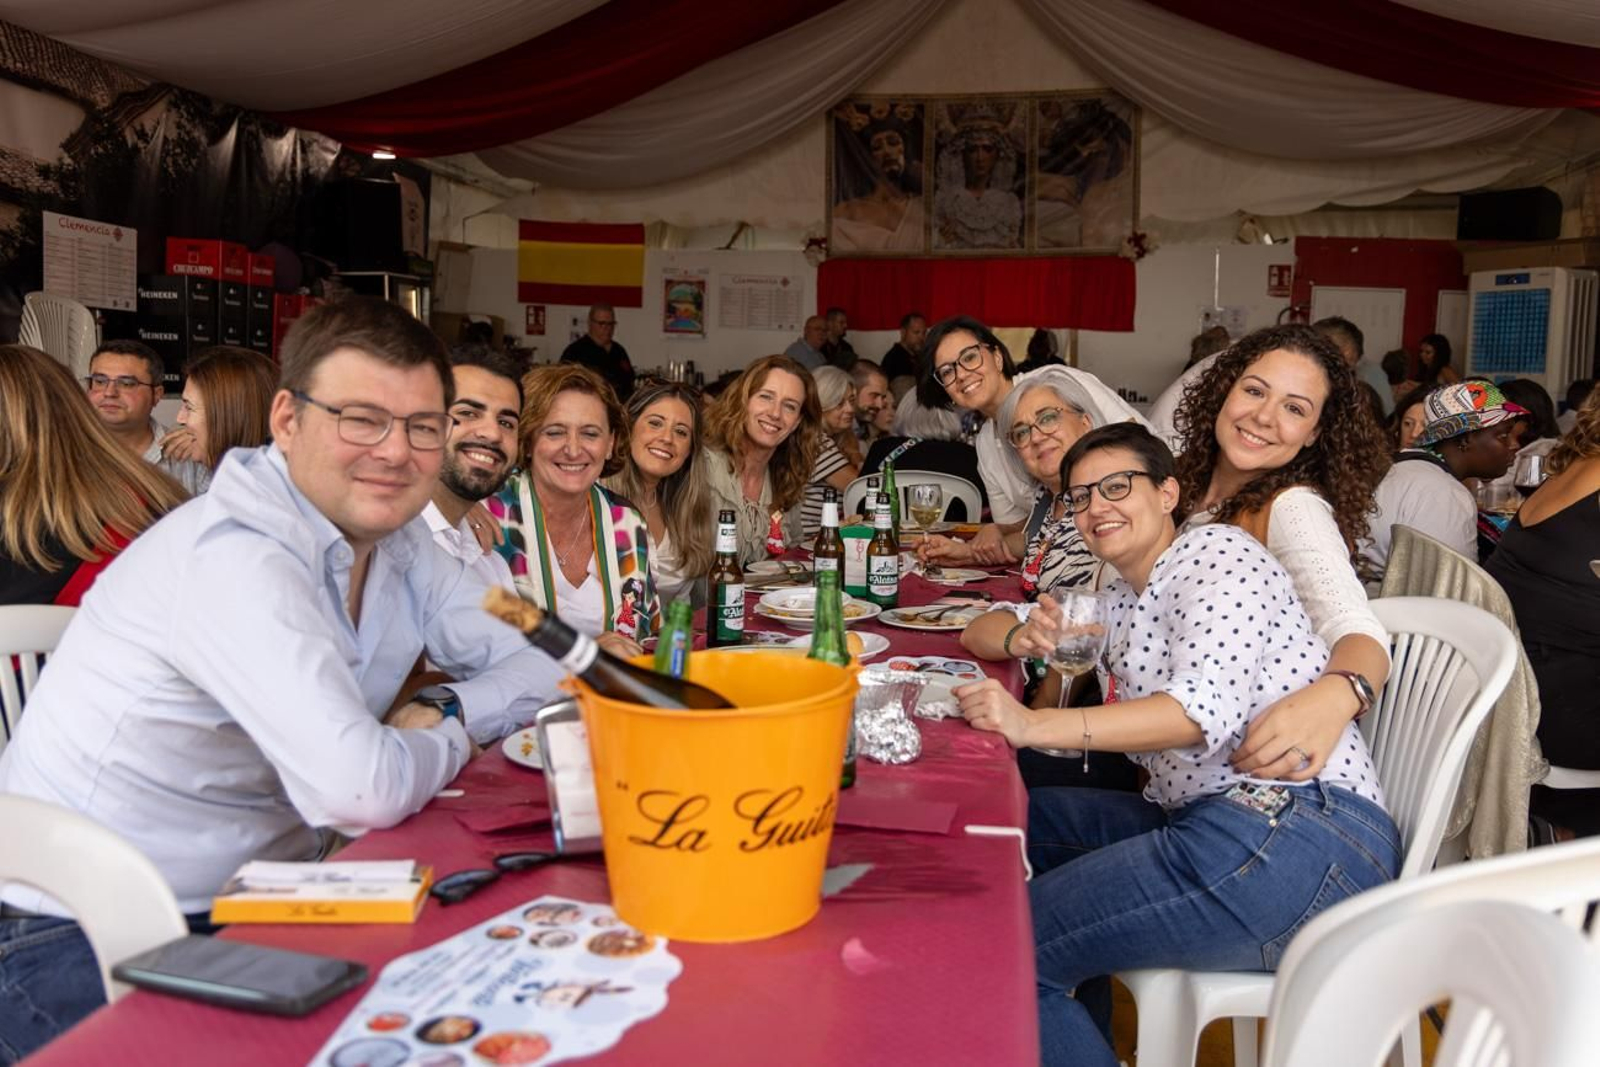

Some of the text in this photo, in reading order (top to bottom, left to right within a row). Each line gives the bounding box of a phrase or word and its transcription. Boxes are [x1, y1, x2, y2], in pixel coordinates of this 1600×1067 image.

[58, 216, 110, 236] Clemencia
[140, 291, 178, 299] HEINEKEN
[141, 332, 179, 341] HEINEKEN
